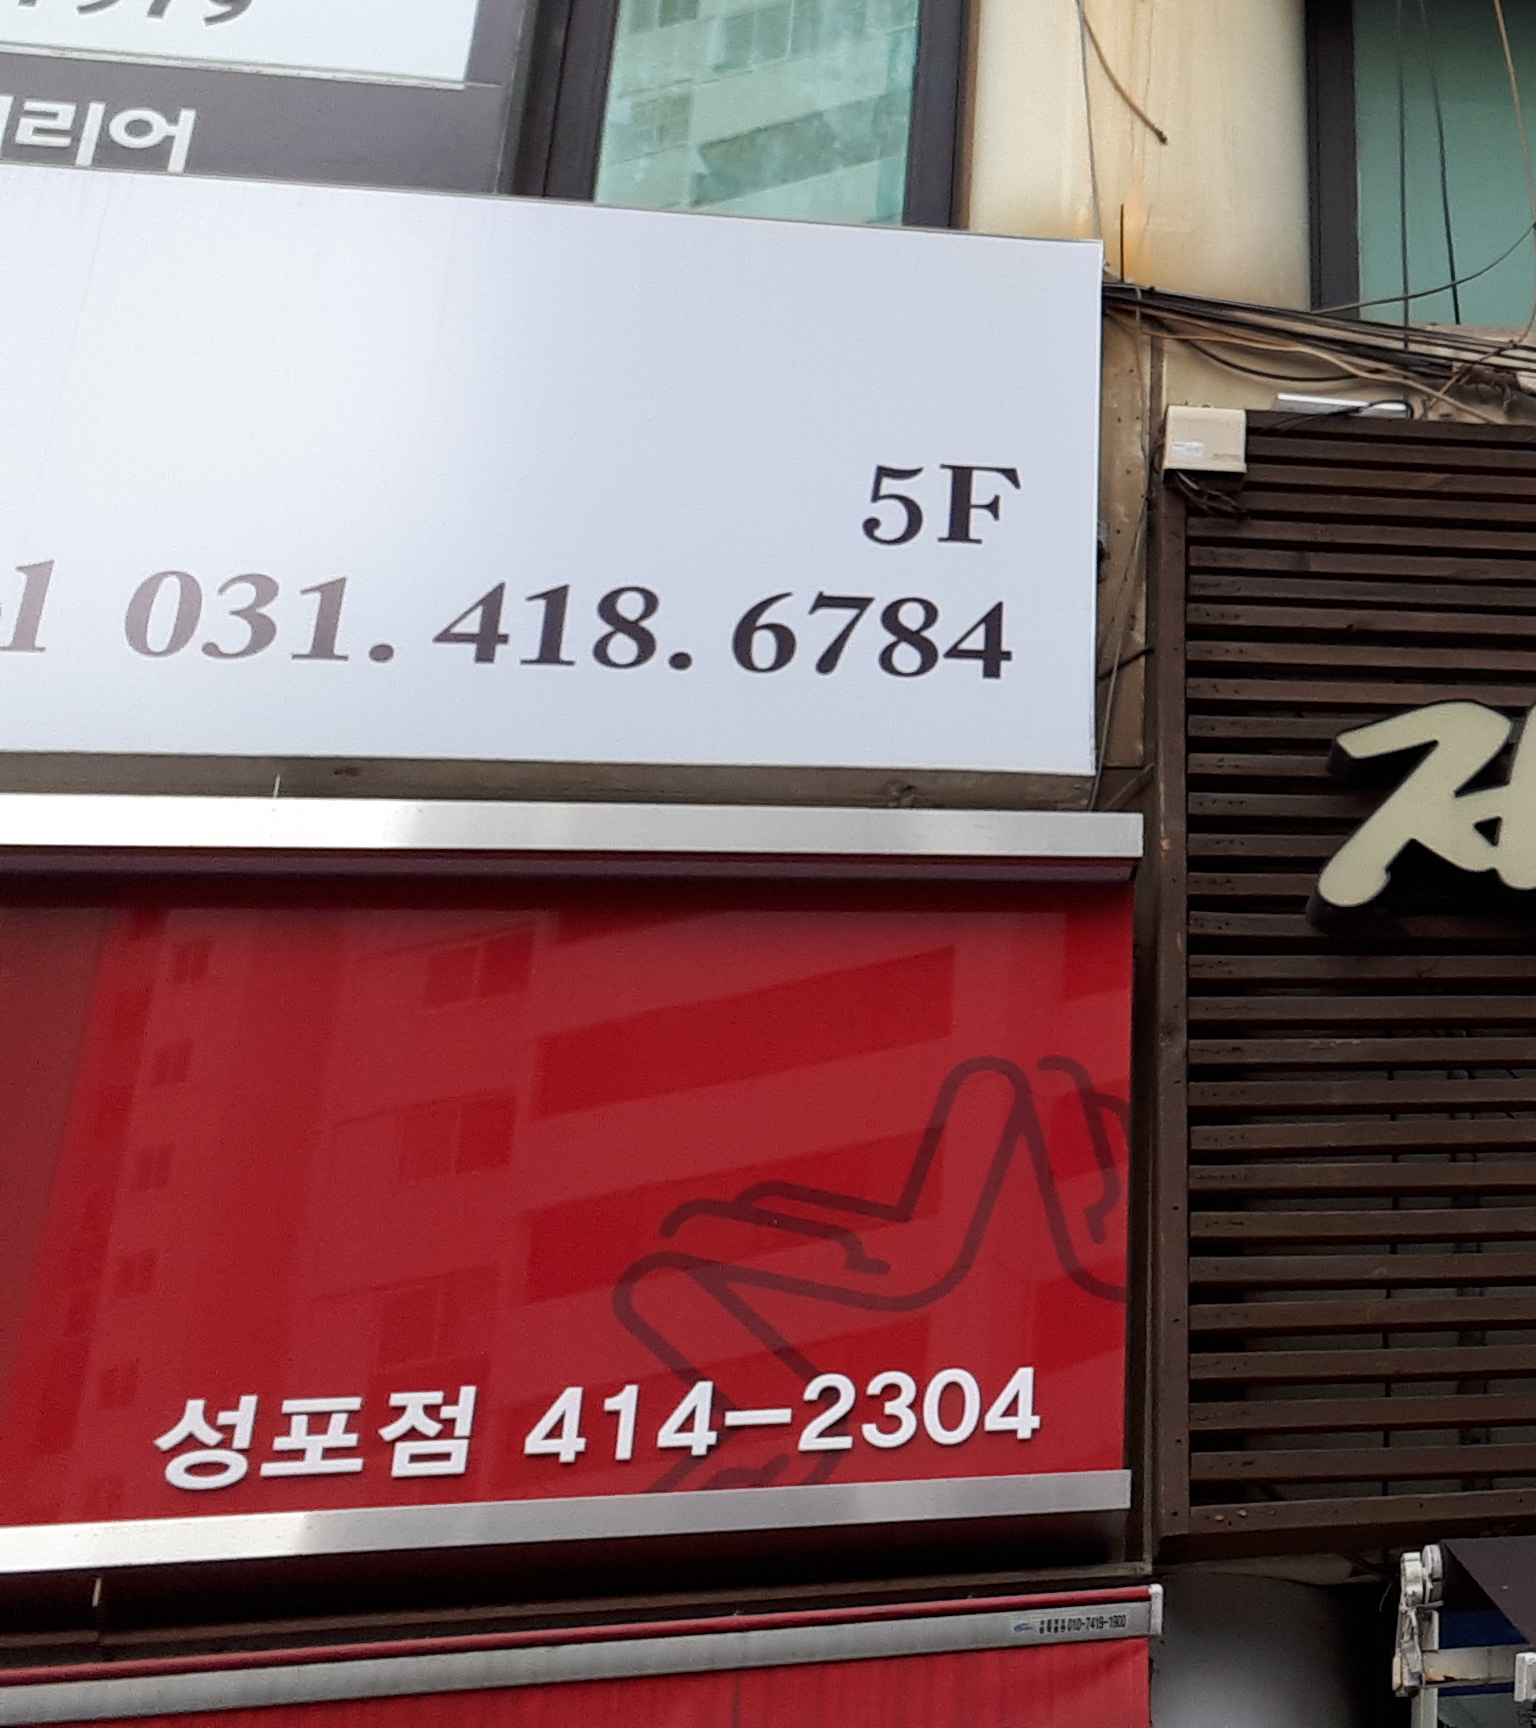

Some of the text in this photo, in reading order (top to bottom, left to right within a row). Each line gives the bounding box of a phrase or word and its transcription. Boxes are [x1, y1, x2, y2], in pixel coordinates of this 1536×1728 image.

[0, 94, 197, 173] 리어
[860, 464, 1021, 547] 5F
[153, 1365, 1042, 1490] 성포점 414-2304
